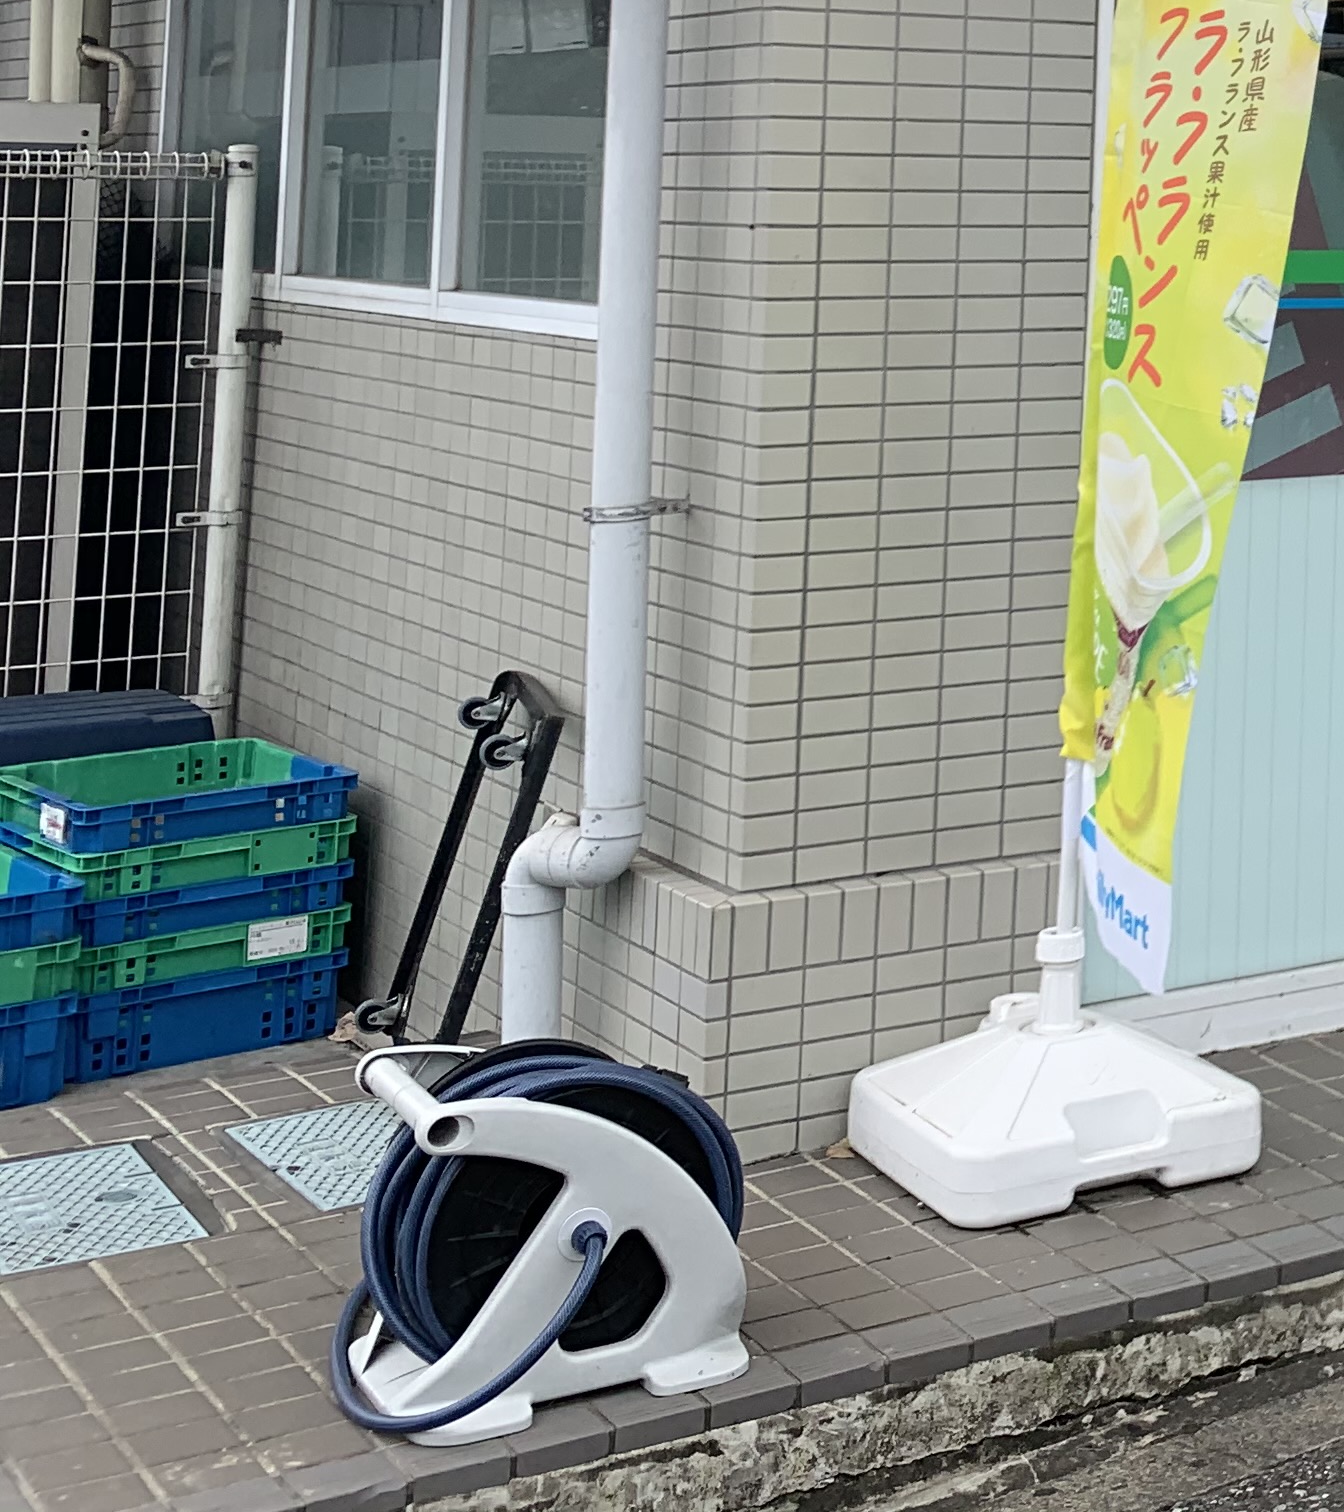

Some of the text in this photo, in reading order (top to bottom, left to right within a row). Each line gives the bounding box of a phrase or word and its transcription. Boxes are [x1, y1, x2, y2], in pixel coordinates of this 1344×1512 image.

[1123, 8, 1190, 255] フラッペ
[1238, 19, 1275, 133] 山形県産
